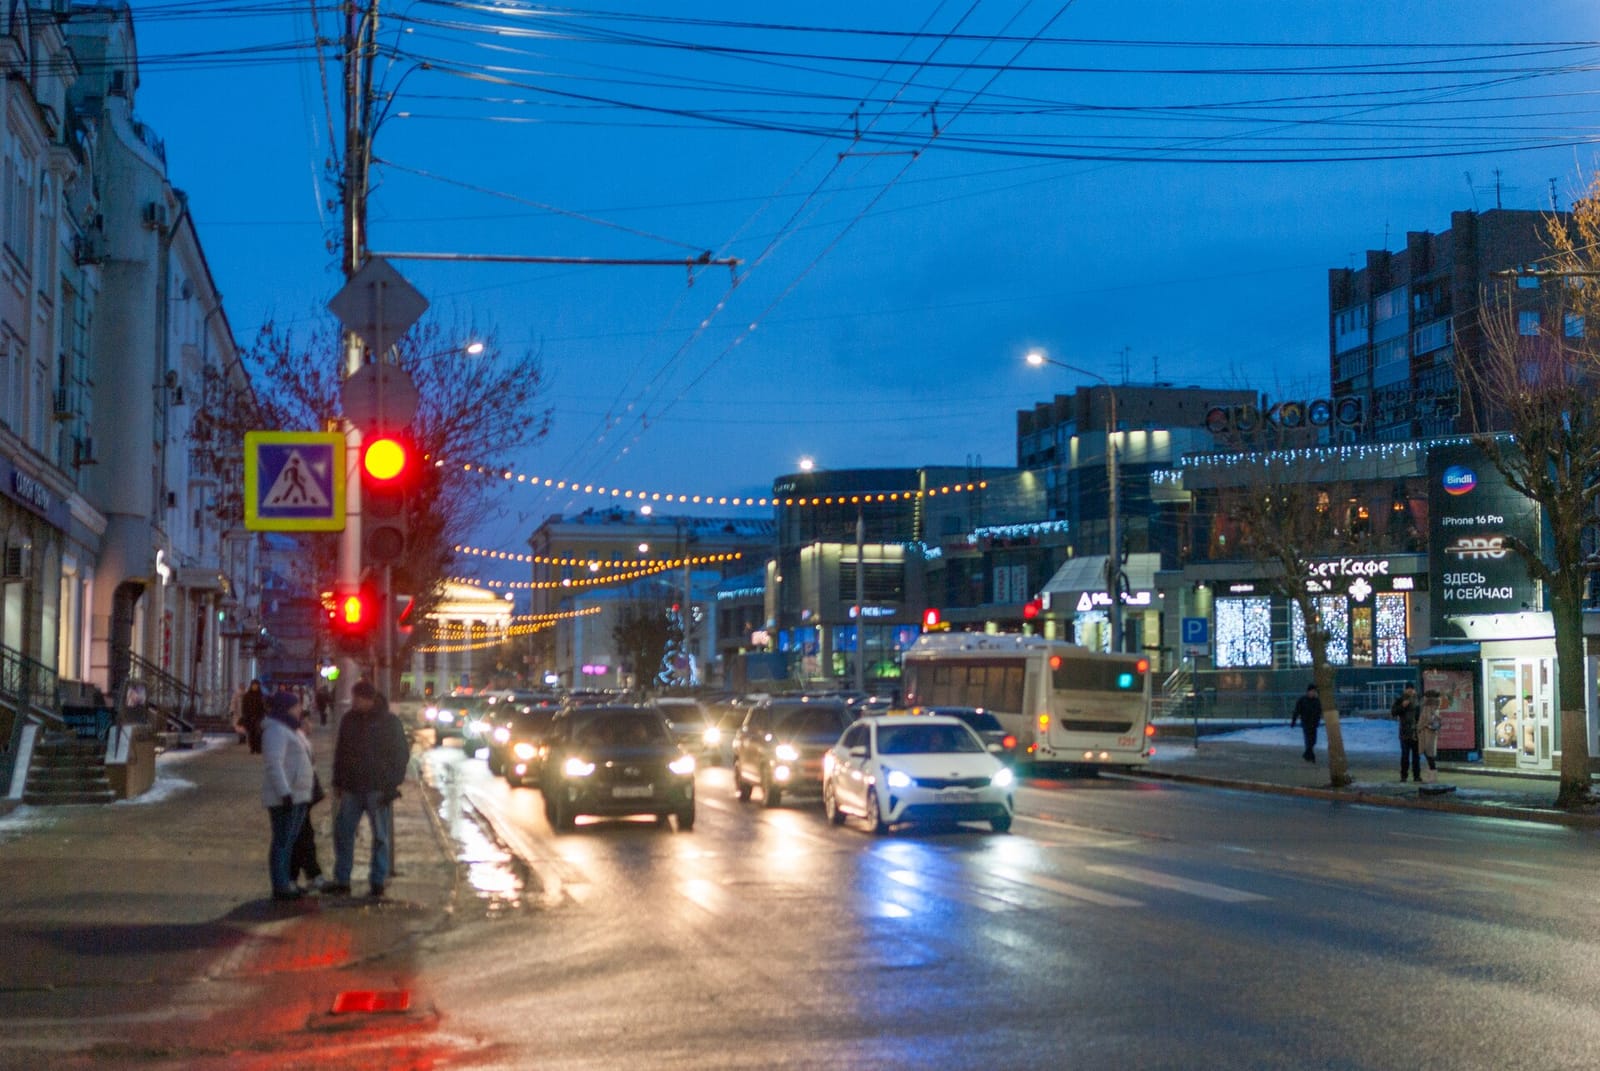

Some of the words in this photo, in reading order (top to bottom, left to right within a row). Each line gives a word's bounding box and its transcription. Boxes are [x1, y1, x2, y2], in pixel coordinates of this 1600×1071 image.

[1443, 516, 1474, 526] iPhone
[1475, 515, 1486, 524] 16
[1487, 514, 1504, 524] Pro
[1443, 572, 1486, 585] ЗДЕСЬ
[1443, 589, 1454, 600] И
[1187, 620, 1202, 640] P
